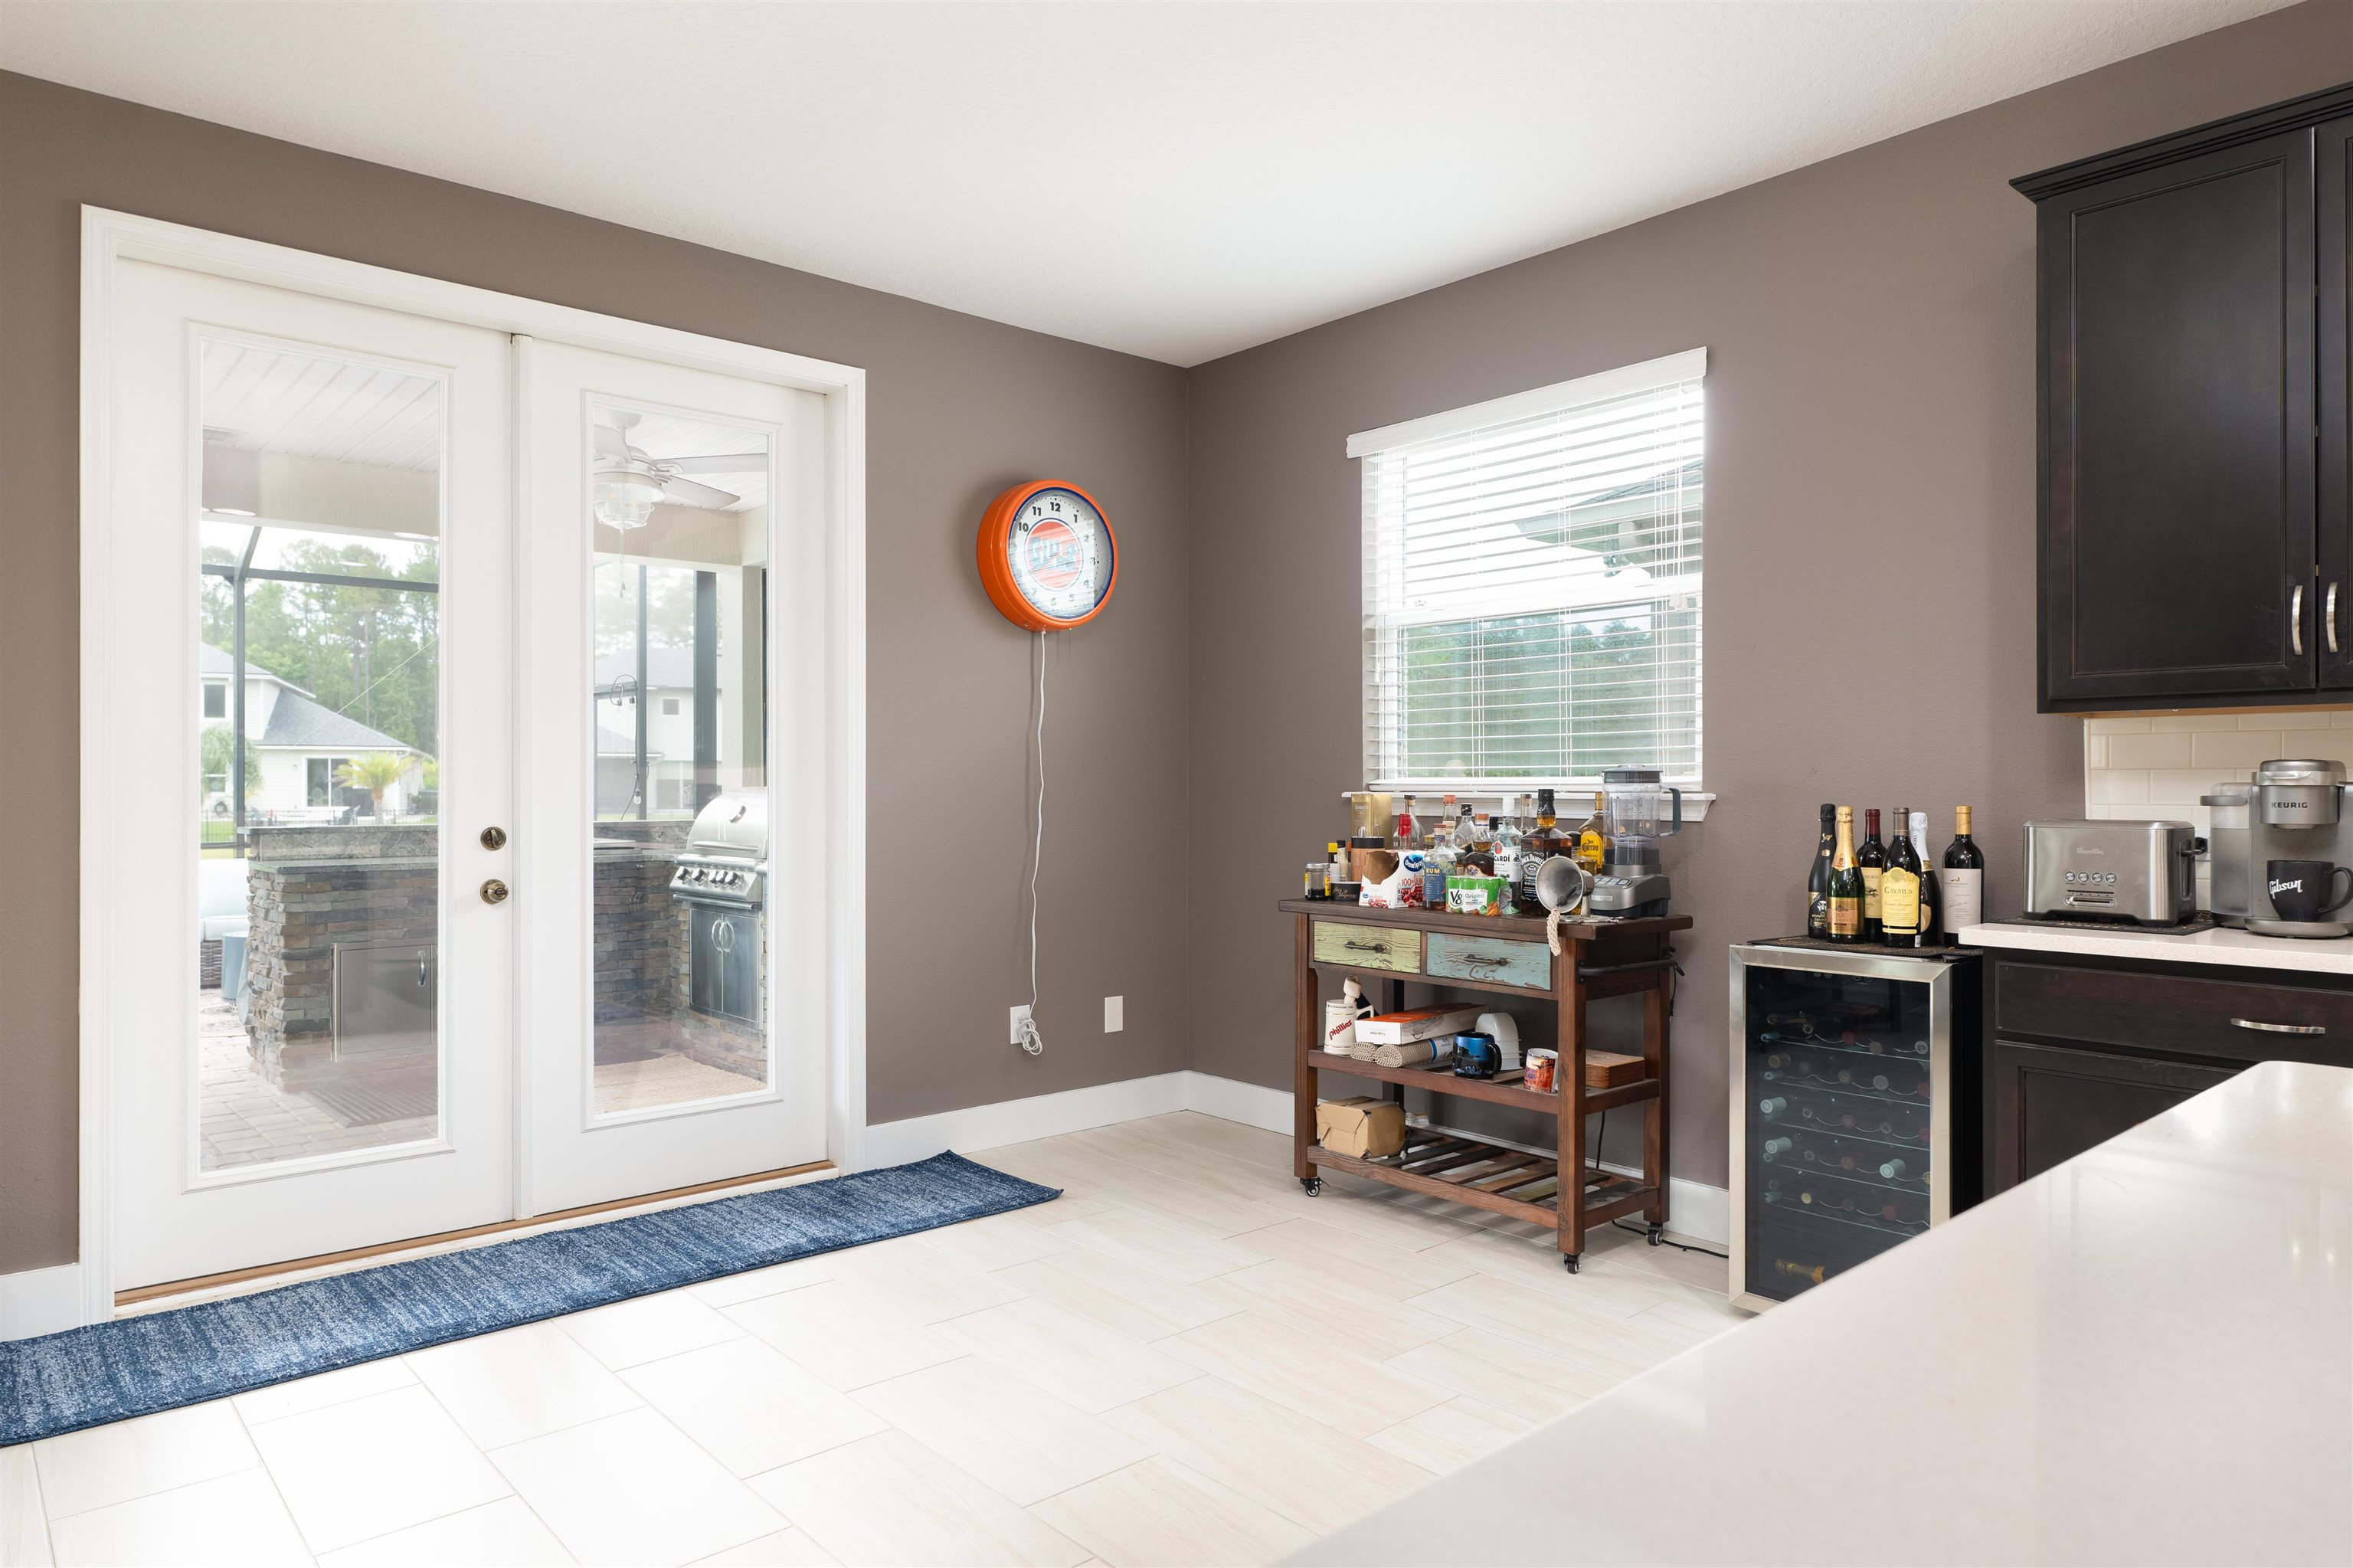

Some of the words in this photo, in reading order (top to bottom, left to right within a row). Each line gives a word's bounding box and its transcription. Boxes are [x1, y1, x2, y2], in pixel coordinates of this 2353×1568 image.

[1033, 506, 1042, 516] 11
[1050, 502, 1061, 512] 12
[1073, 514, 1078, 523] 1
[1018, 522, 1029, 532] 10
[1083, 534, 1089, 542] 2
[1090, 557, 1096, 565] 3
[1582, 843, 1599, 852] Cuervo
[1884, 886, 1913, 895] CAYMUS
[2269, 879, 2302, 899] Gibson
[1450, 890, 1463, 905] V8
